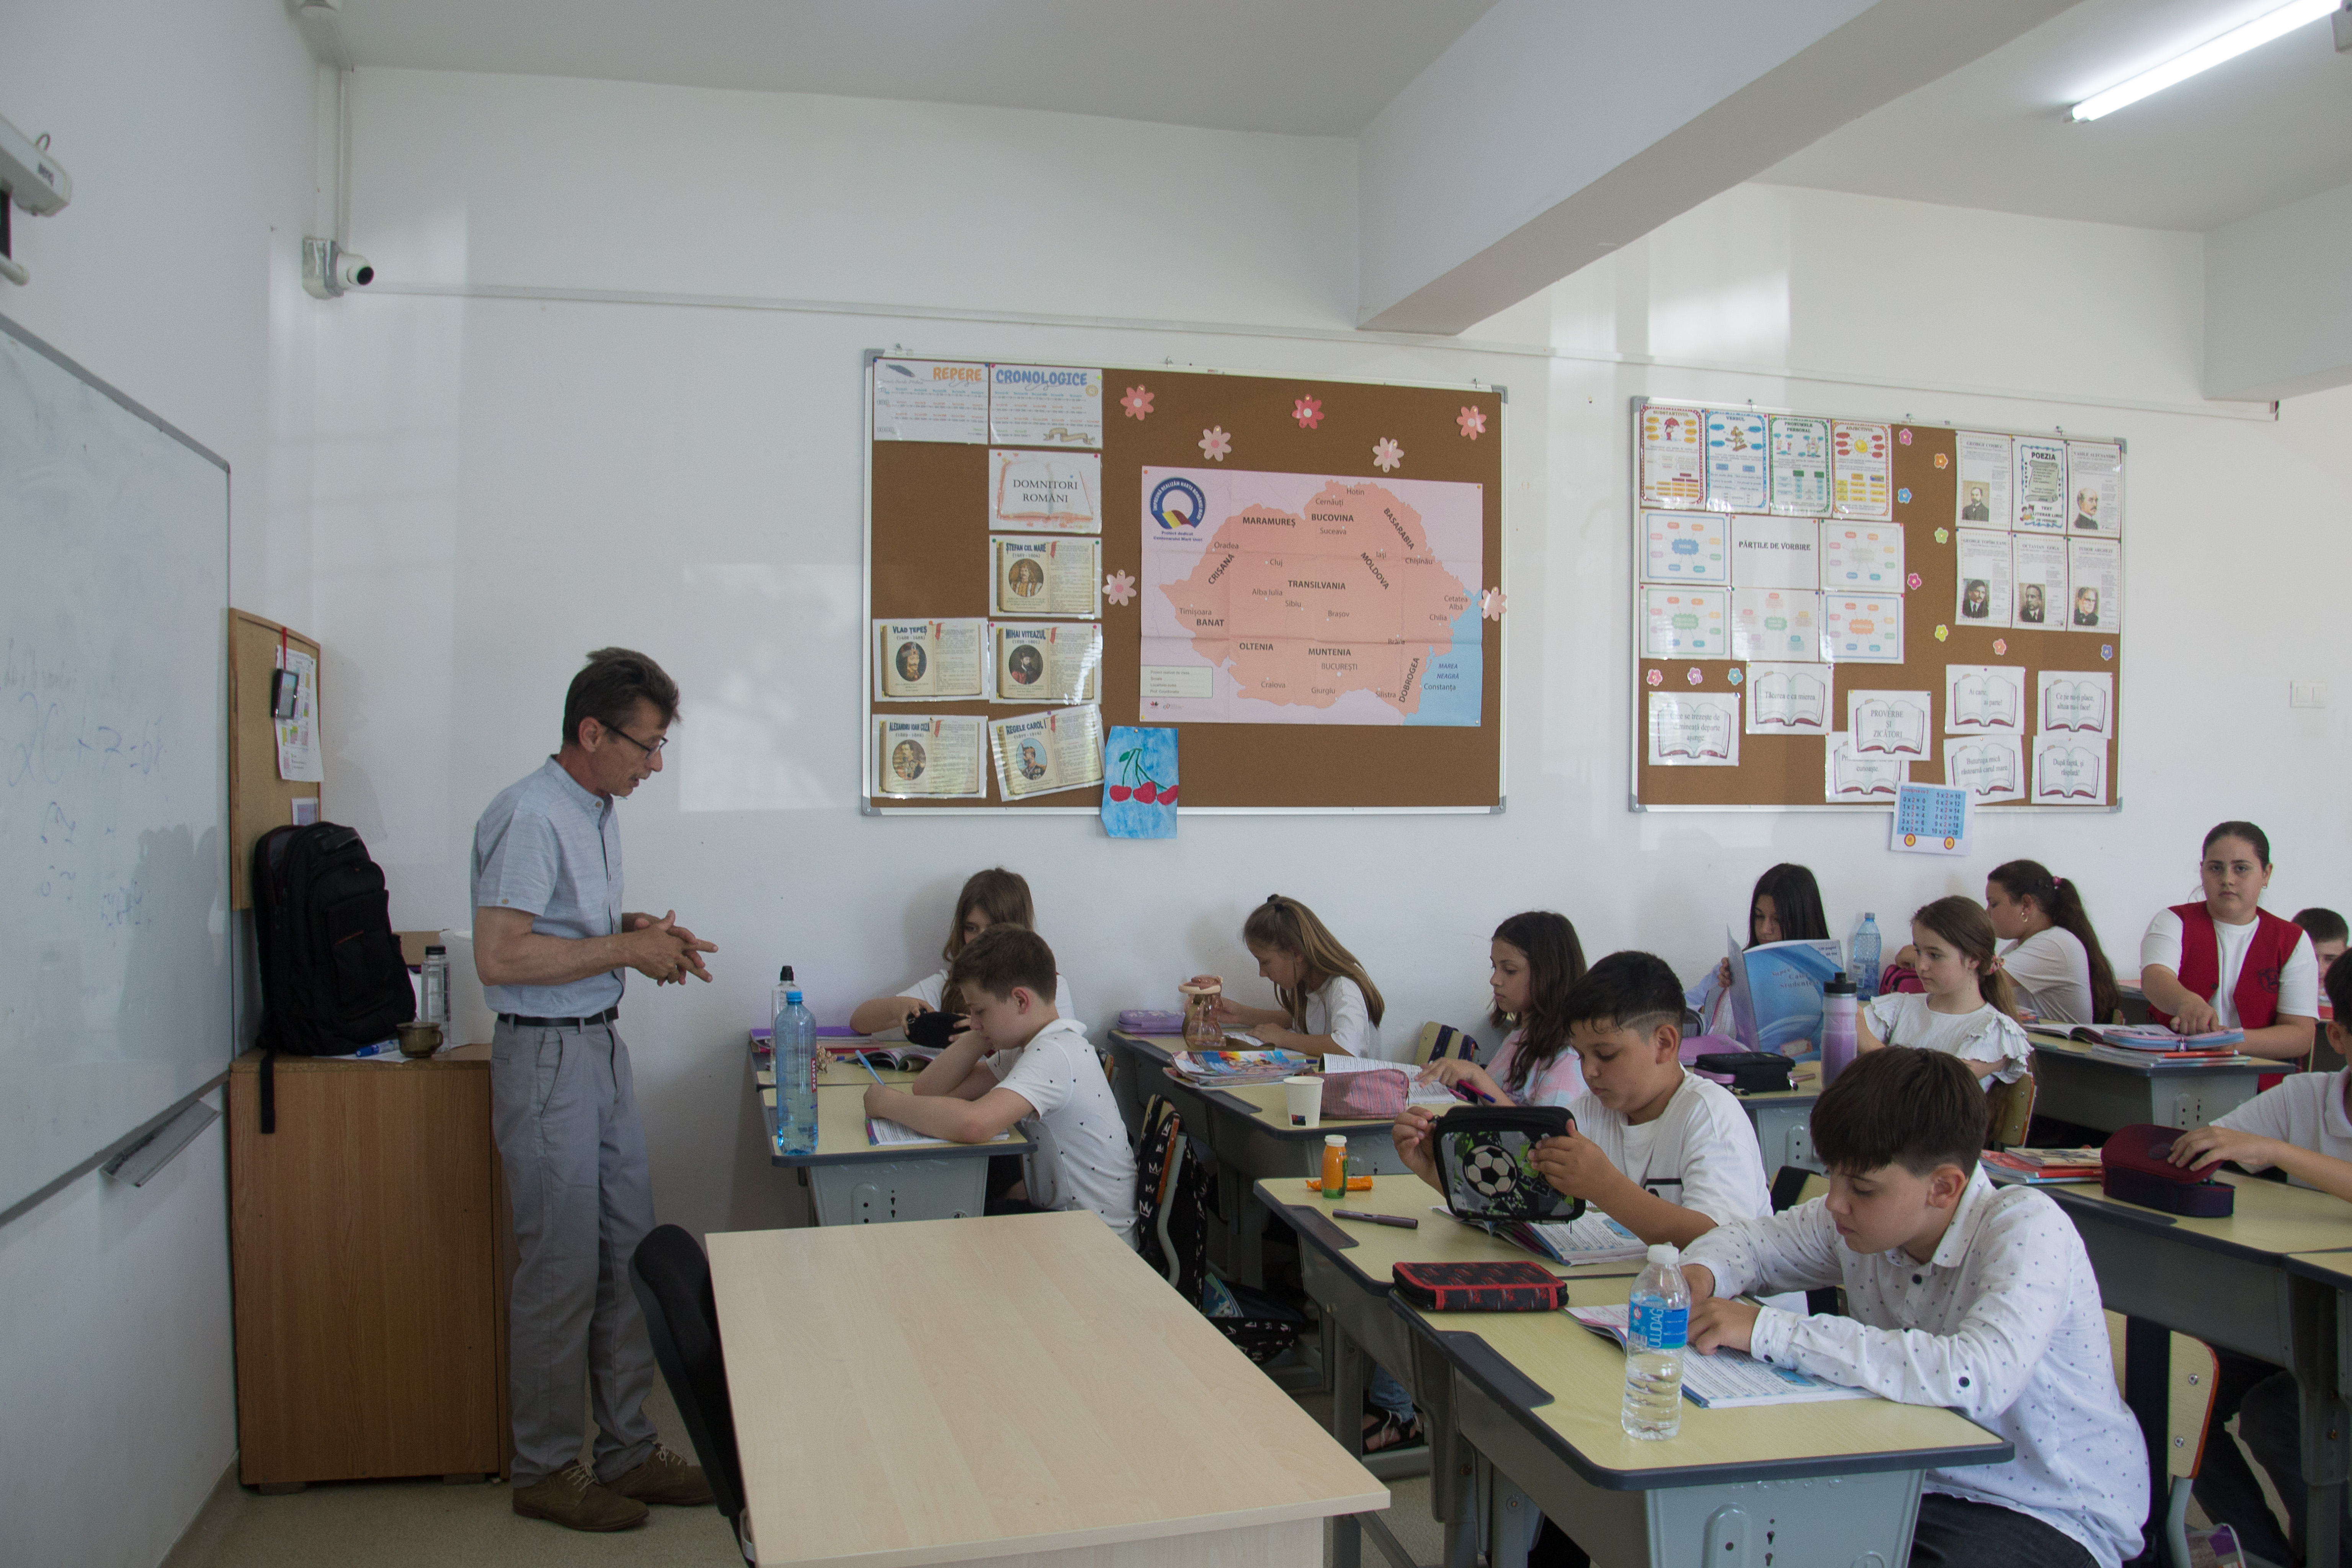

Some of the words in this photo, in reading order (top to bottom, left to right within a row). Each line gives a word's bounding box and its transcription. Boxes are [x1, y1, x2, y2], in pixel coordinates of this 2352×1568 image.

[933, 366, 982, 382] REPERE
[996, 369, 1088, 386] CRONOLOGICE
[2031, 452, 2056, 461] POEZIA
[1013, 479, 1078, 490] DOMNITORI
[1243, 517, 1296, 528] MARAMUREȘ
[1312, 514, 1354, 522] BUCOVINA
[1384, 508, 1414, 550] BASARABIA
[1006, 542, 1023, 554] ȘTEFAN
[1034, 543, 1046, 552] MARE
[1208, 554, 1235, 585] CRIȘANA
[1361, 552, 1389, 590] MOLDOVA
[1288, 580, 1346, 590] TRANSILVANIA
[1179, 608, 1212, 616] Timișoara
[909, 626, 927, 636] ȚEPEȘ
[1006, 629, 1020, 639] MIHAI
[1022, 630, 1046, 639] VITEAZUL
[1308, 648, 1351, 656] MUNTENIA
[1321, 663, 1358, 671] BUCUREȘTI
[1399, 658, 1420, 703] DOBROGEA
[1424, 683, 1456, 691] Constanța
[1871, 710, 1904, 718] PROVERBE
[1006, 724, 1026, 735] REGELE
[1026, 720, 1044, 730] CAROL
[1044, 719, 1047, 729] I
[1701, 724, 1720, 732] departe
[1873, 730, 1902, 738] ZICĂTORI
[1648, 1308, 1664, 1348] ULUDAĞ
